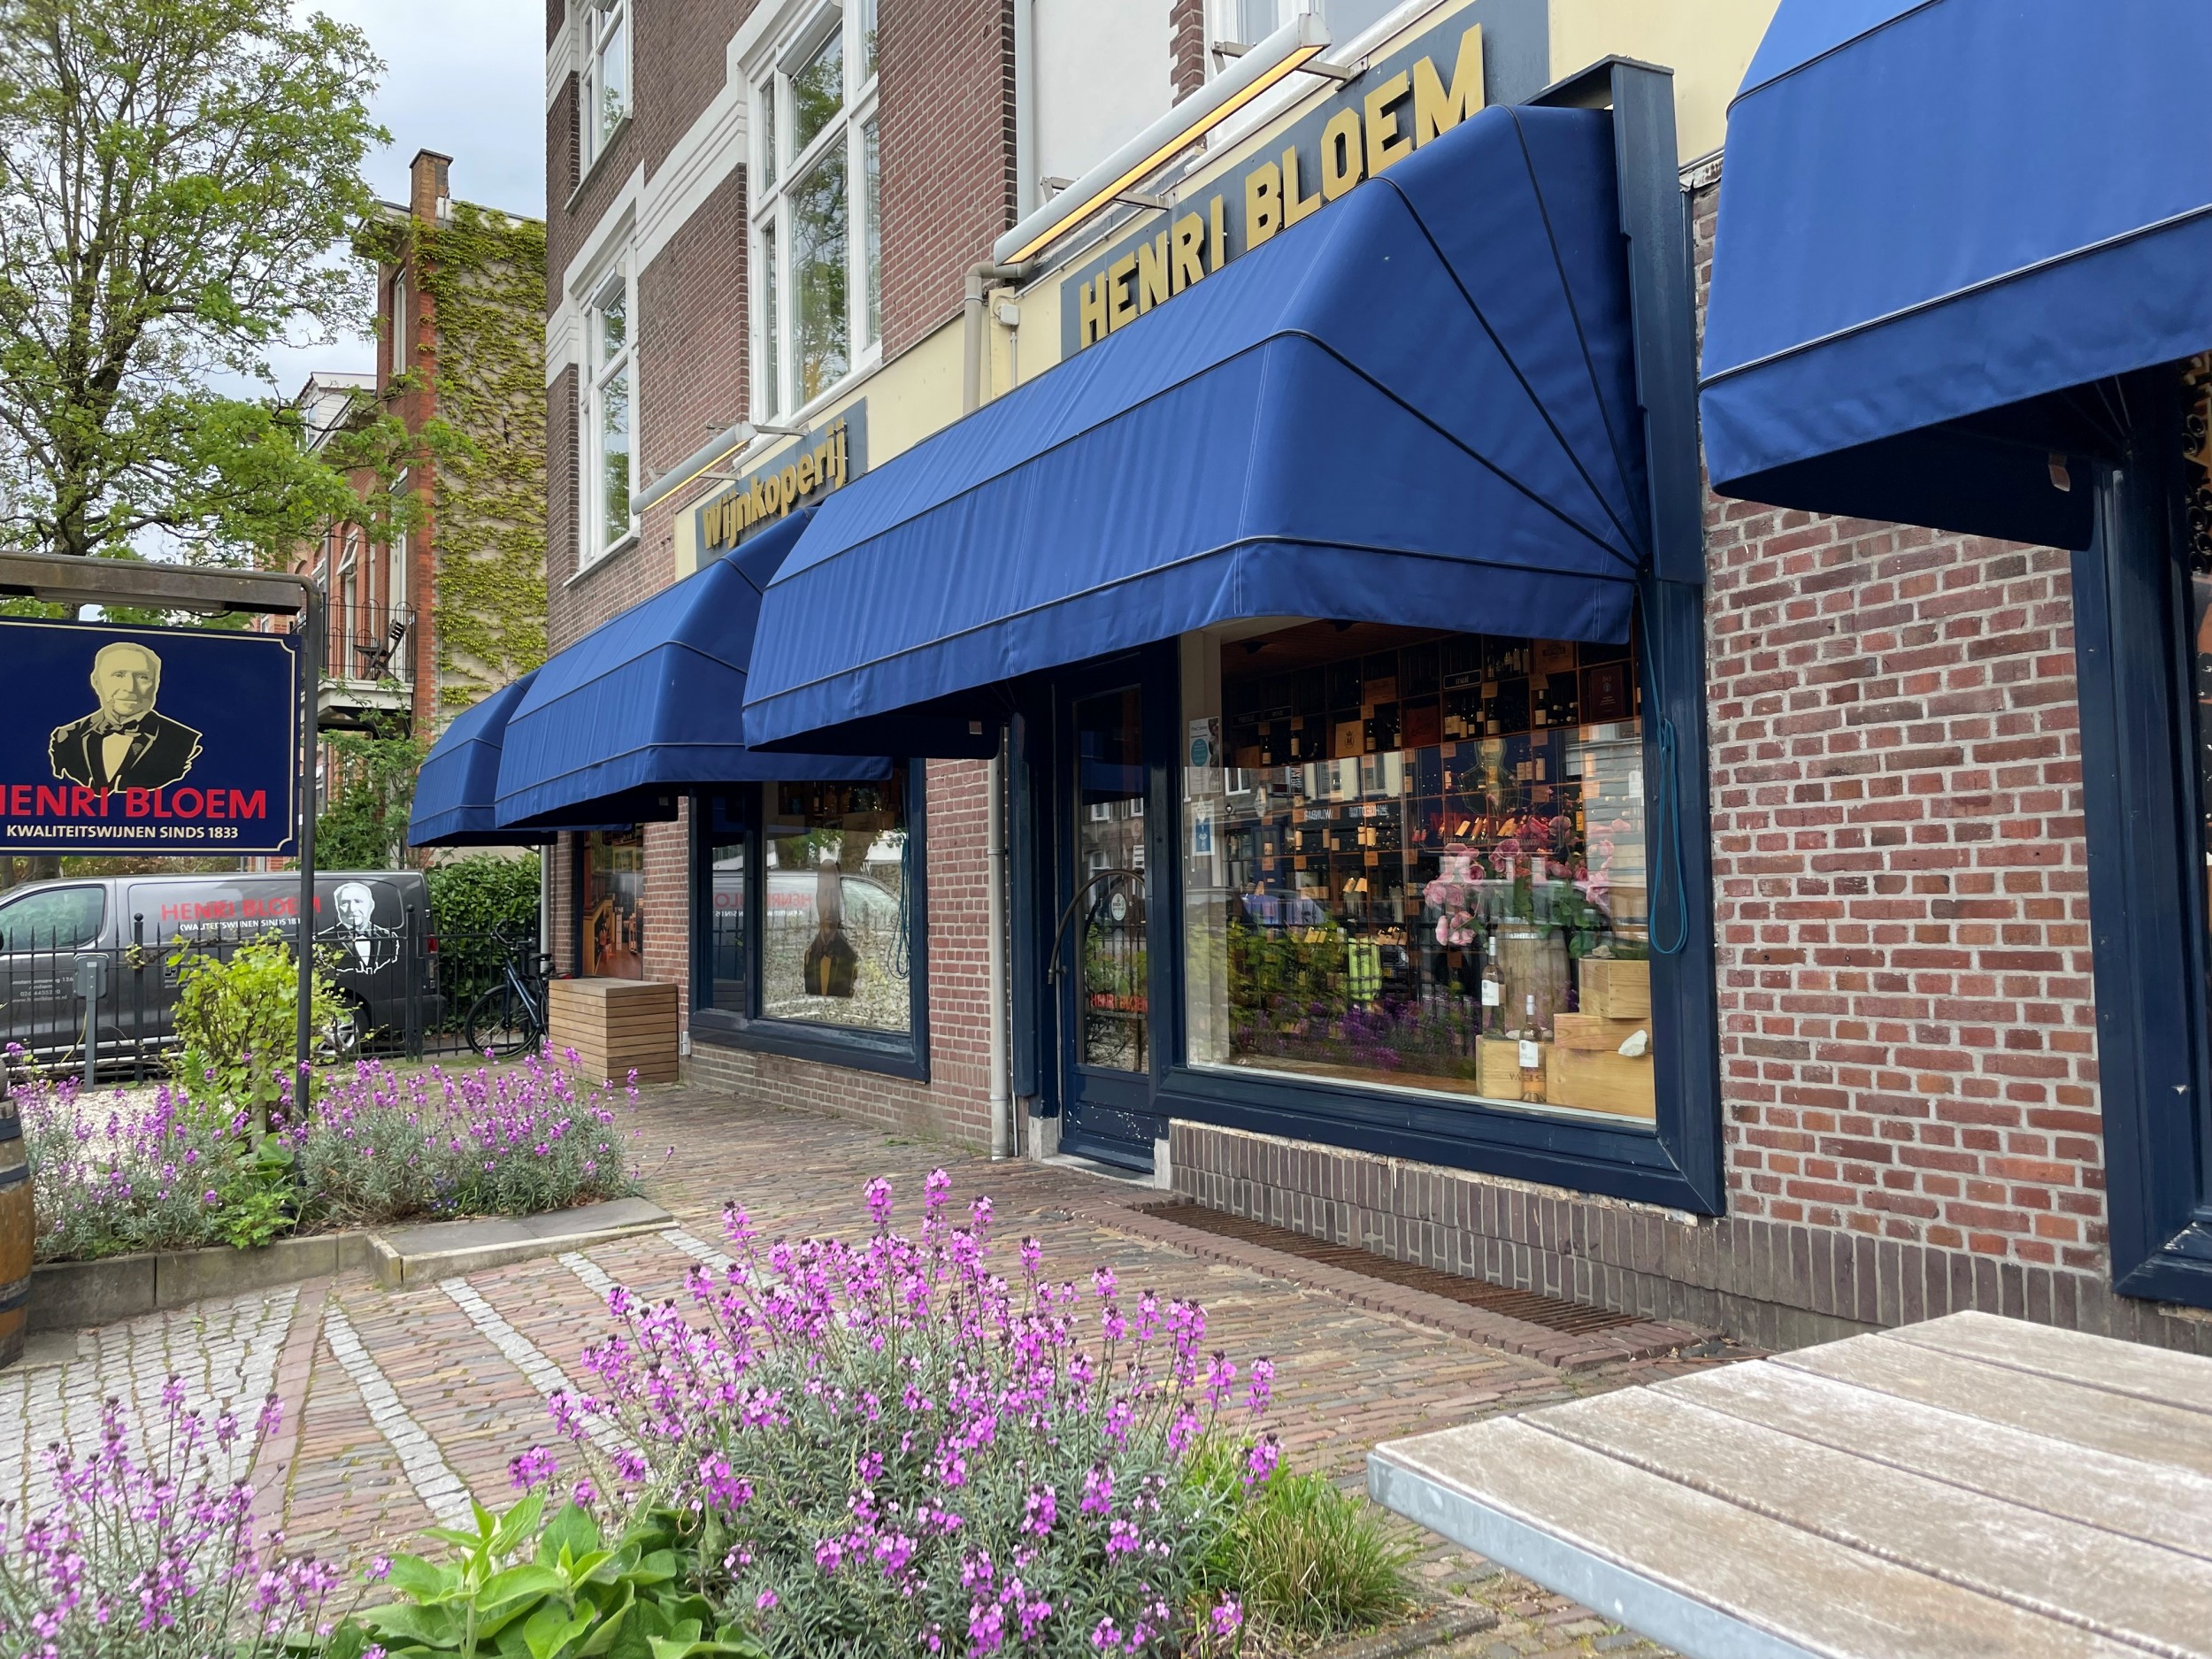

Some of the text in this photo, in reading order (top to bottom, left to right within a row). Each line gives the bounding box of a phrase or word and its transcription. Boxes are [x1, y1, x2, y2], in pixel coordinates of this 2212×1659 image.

[1079, 22, 1486, 349] HENRI BLOEM
[703, 418, 849, 549] Wijnkoperij
[126, 787, 265, 818] BLOEM
[7, 825, 238, 839] KWALITEITSWIJNEN SINDS 1833
[161, 901, 234, 921] HENRI
